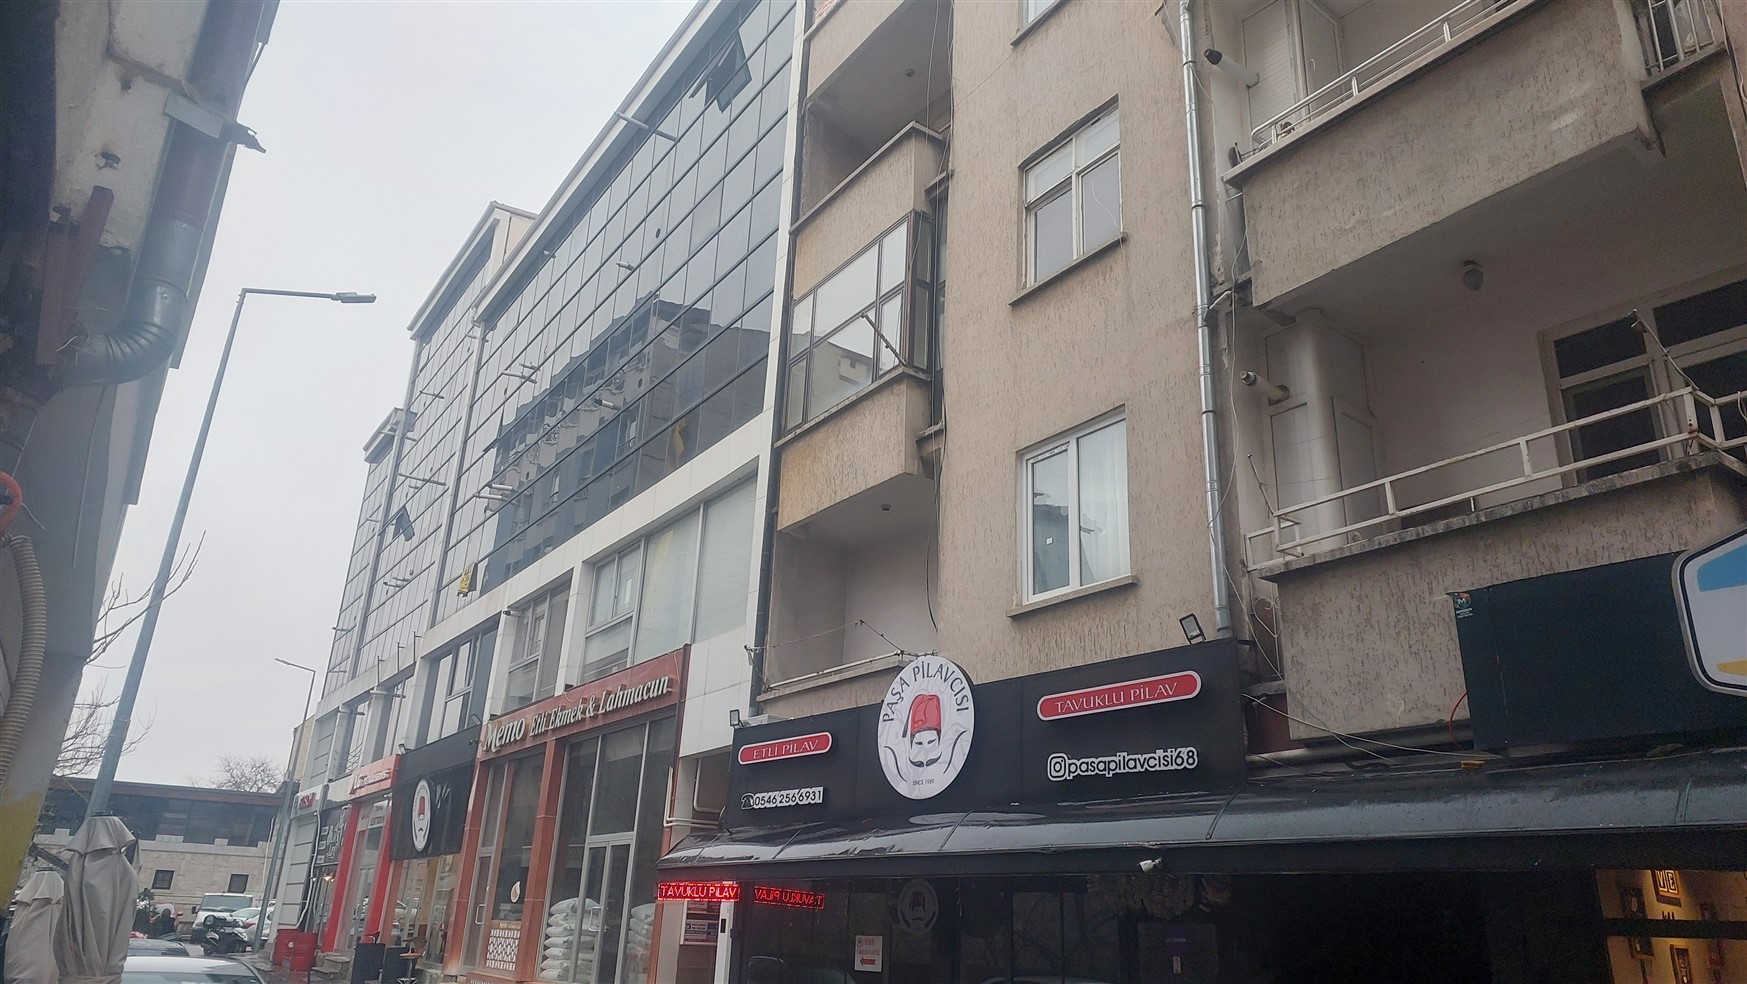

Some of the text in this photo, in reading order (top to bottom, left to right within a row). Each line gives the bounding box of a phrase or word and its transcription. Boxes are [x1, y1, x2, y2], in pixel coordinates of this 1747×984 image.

[882, 660, 969, 723] PAŞA PİLAVCISI
[1055, 682, 1177, 713] TAVUKLU PİLAV
[483, 675, 670, 753] Memo Etli Ekmek & Lahmacun
[753, 739, 819, 759] ETLİ PİLAV
[660, 885, 707, 897] TAVUKLU
